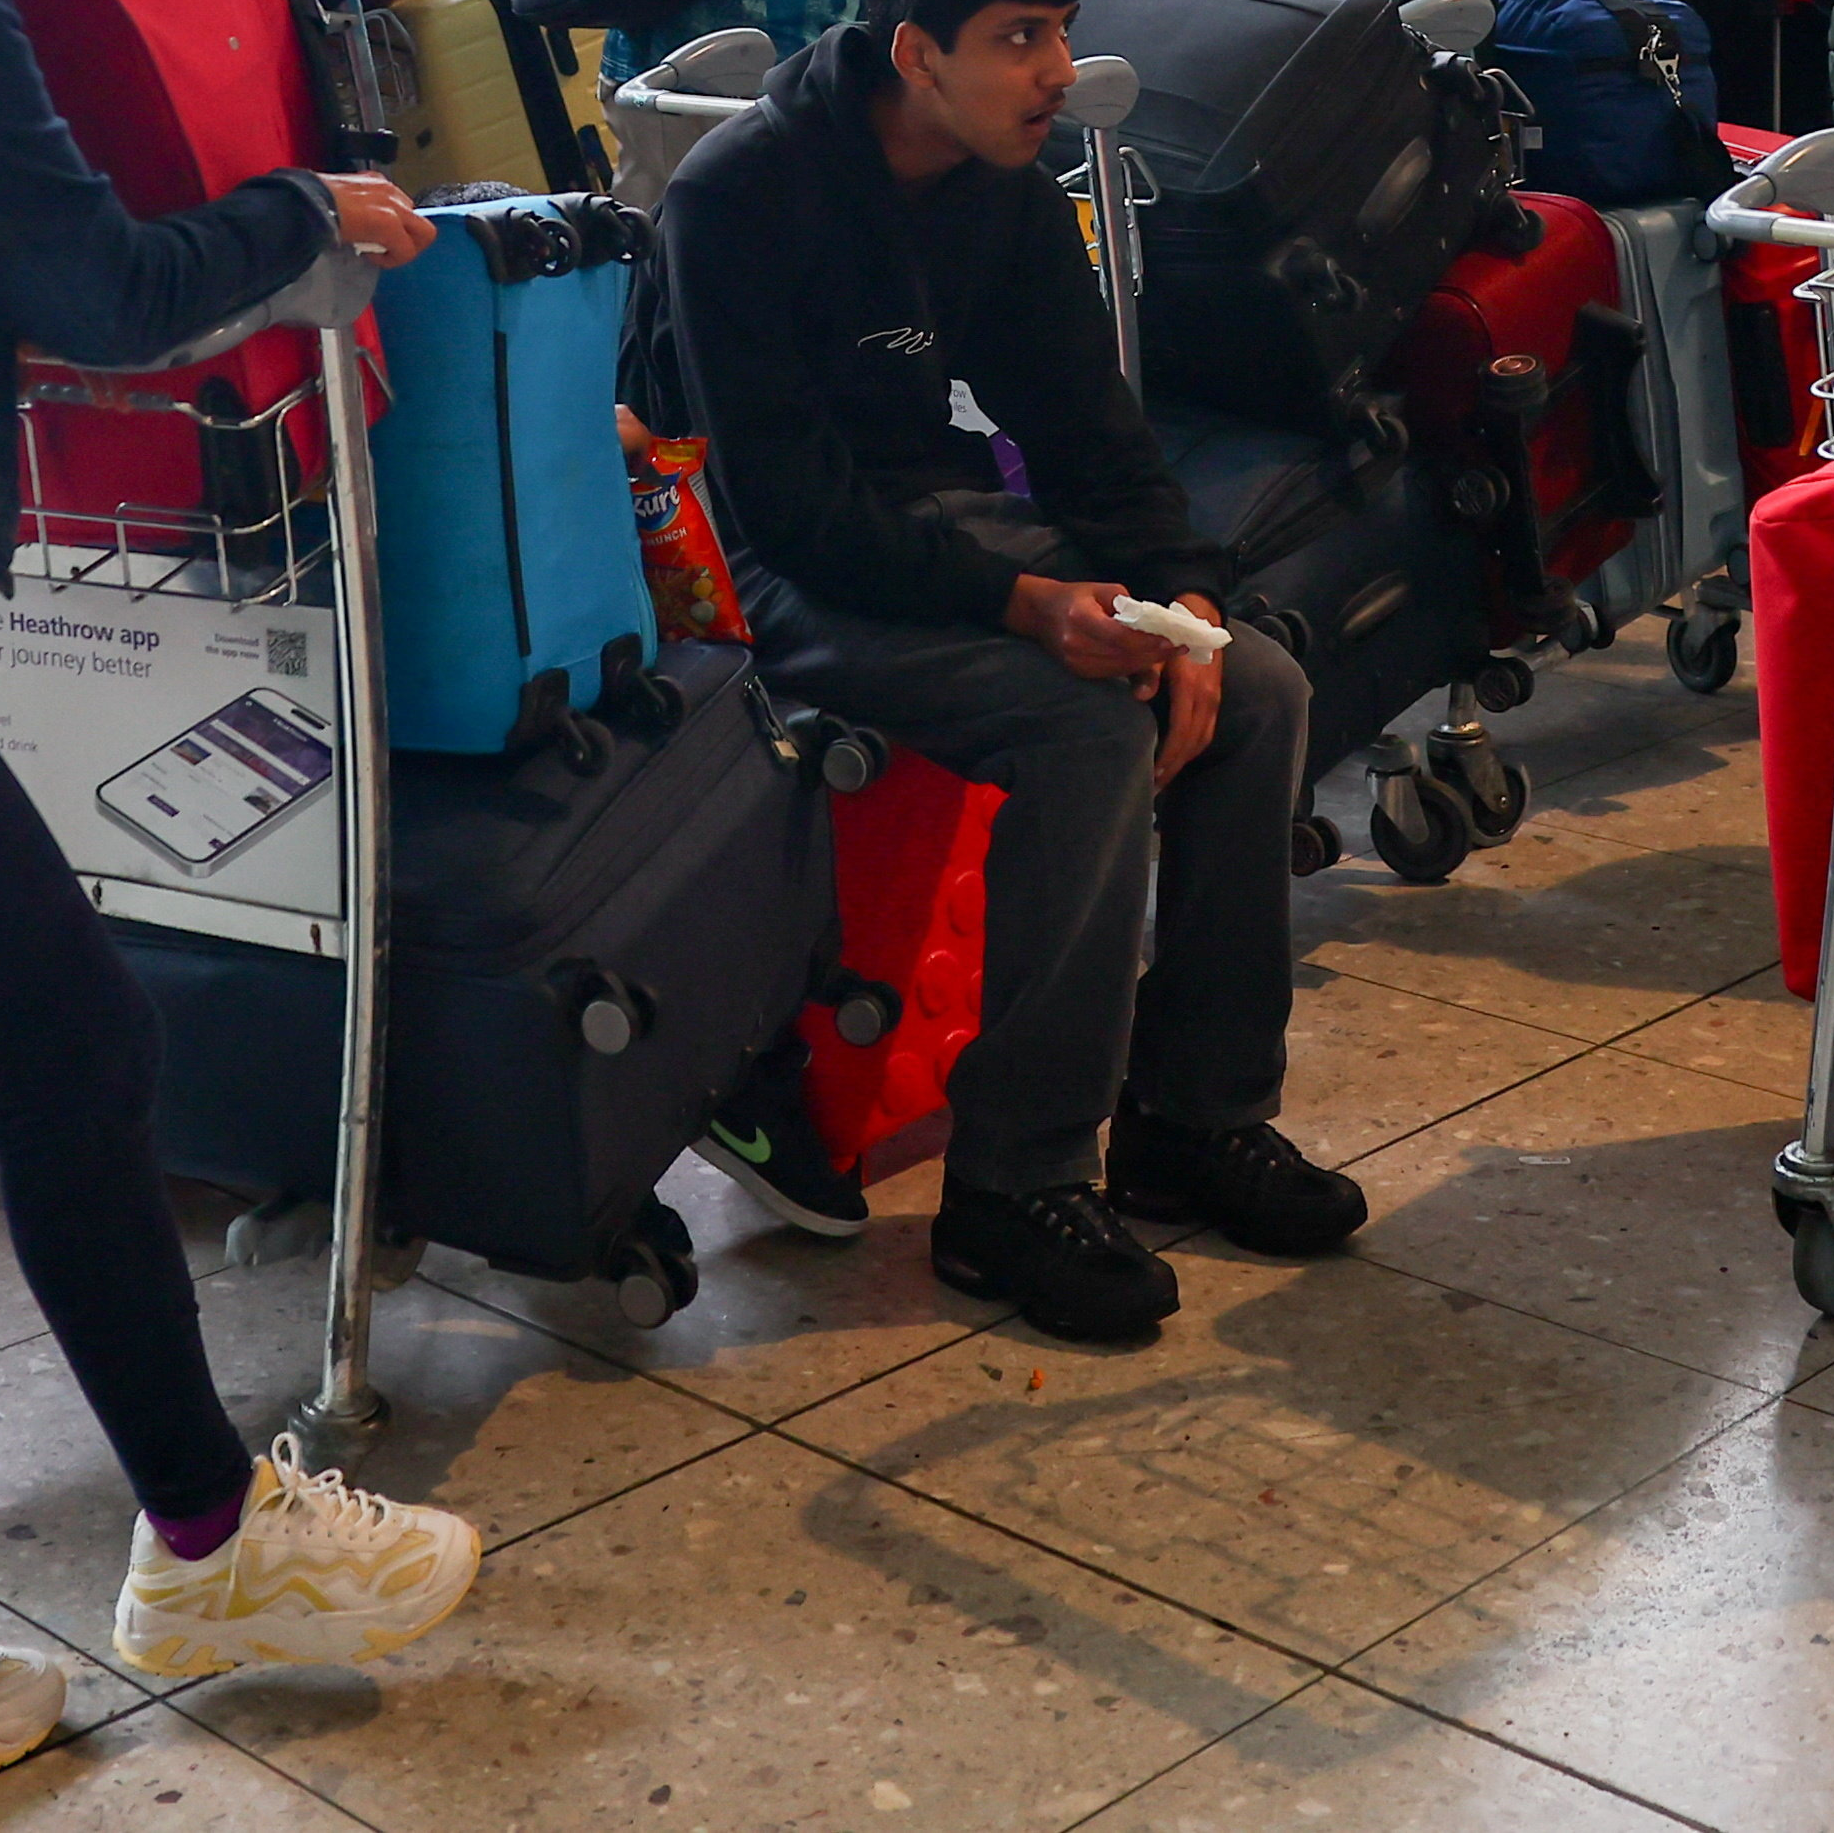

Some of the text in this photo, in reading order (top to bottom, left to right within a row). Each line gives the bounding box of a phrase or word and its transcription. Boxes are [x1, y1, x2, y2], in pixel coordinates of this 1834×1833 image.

[10, 612, 114, 642] Heathrow
[120, 629, 160, 652] app
[11, 647, 85, 676] journey
[92, 655, 152, 679] better
